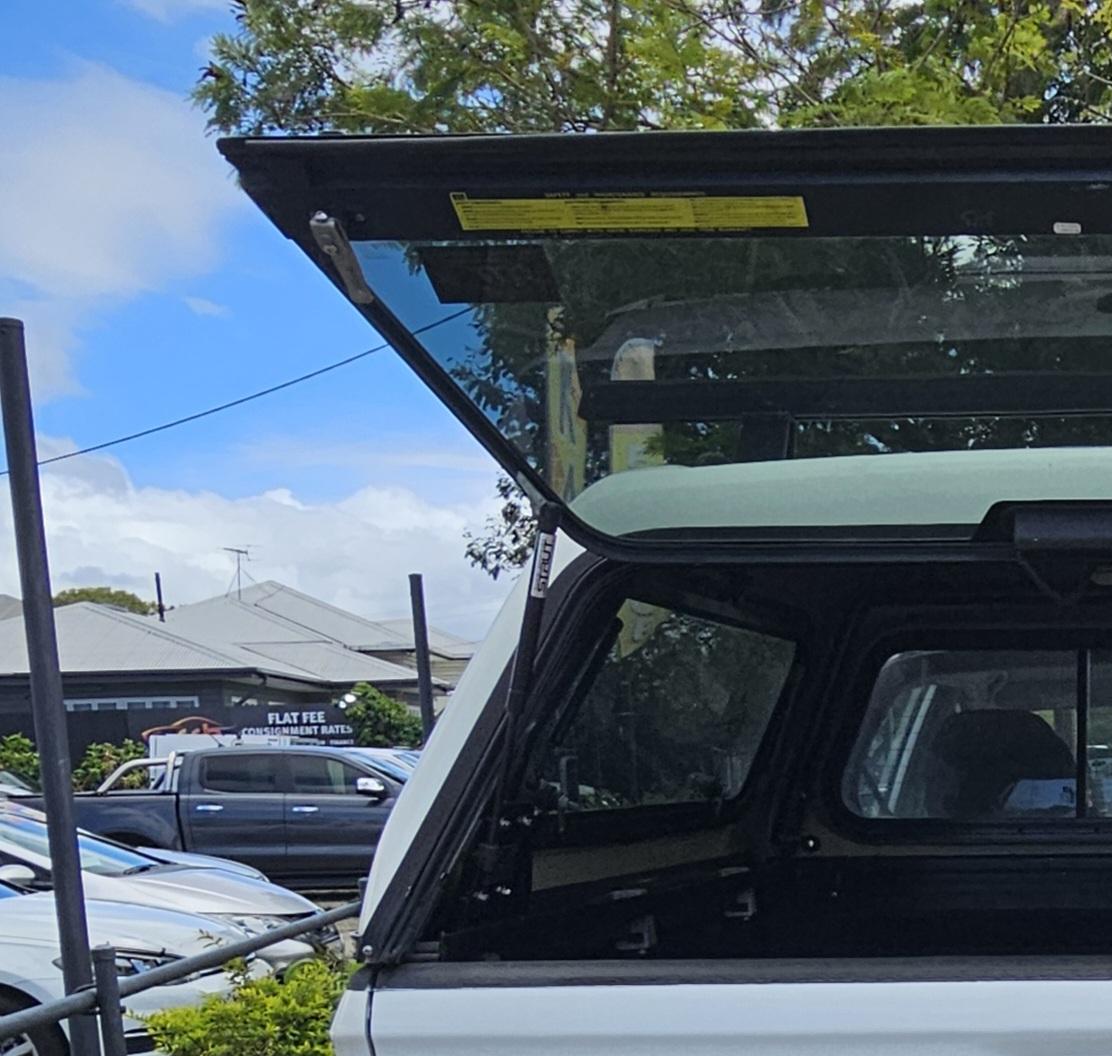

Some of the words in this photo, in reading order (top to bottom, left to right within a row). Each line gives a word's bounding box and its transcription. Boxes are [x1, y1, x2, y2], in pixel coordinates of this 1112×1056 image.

[268, 712, 299, 724] FLAT
[303, 711, 325, 723] FEE
[242, 725, 318, 736] CONSIGNMENT
[321, 725, 352, 734] RATES
